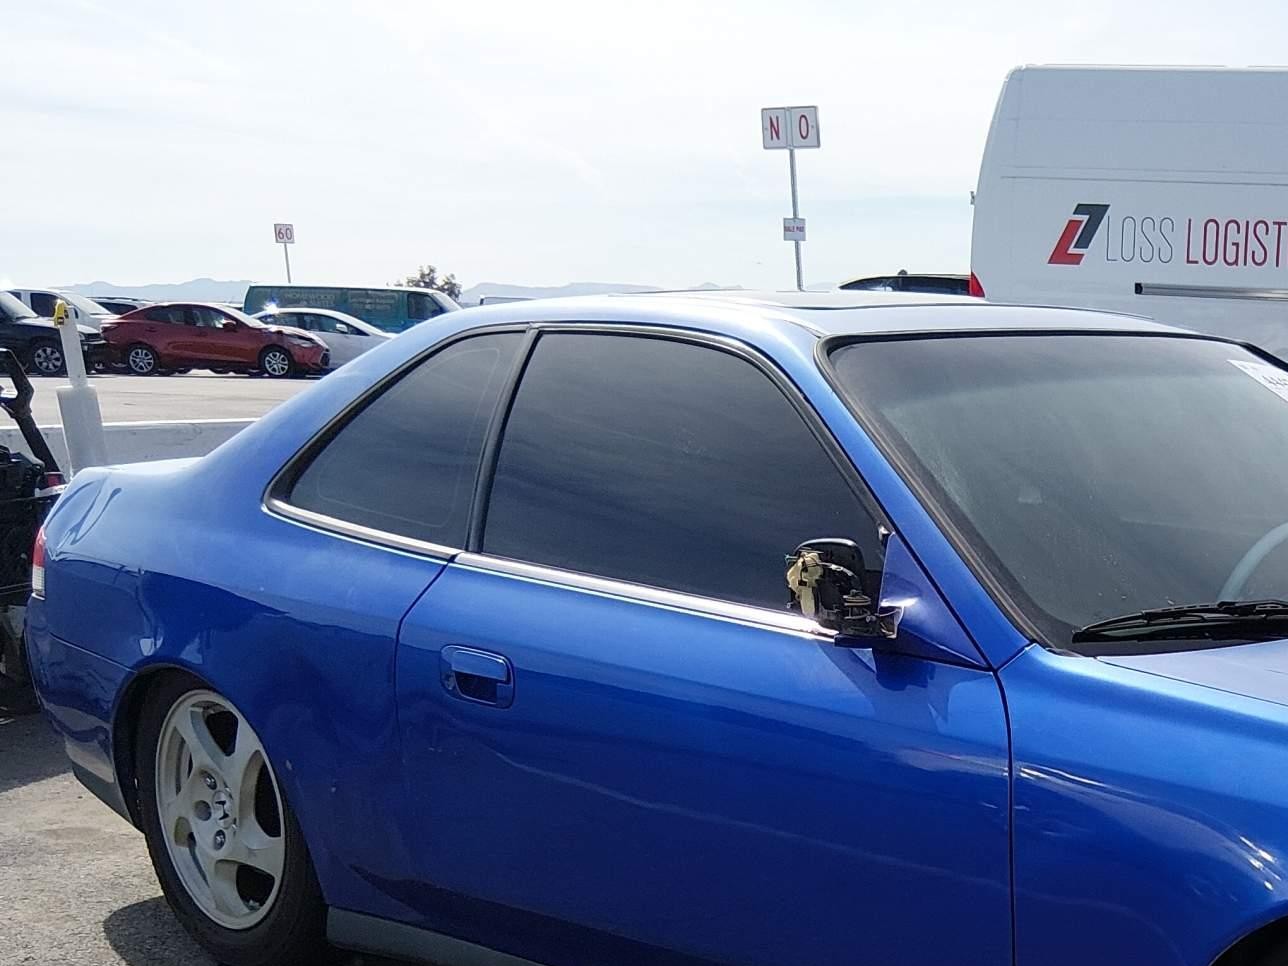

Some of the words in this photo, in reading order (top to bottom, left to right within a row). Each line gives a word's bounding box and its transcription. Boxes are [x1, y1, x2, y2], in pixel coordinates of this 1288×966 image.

[769, 115, 780, 141] N
[277, 227, 293, 241] 60
[1106, 215, 1174, 263] LOSS
